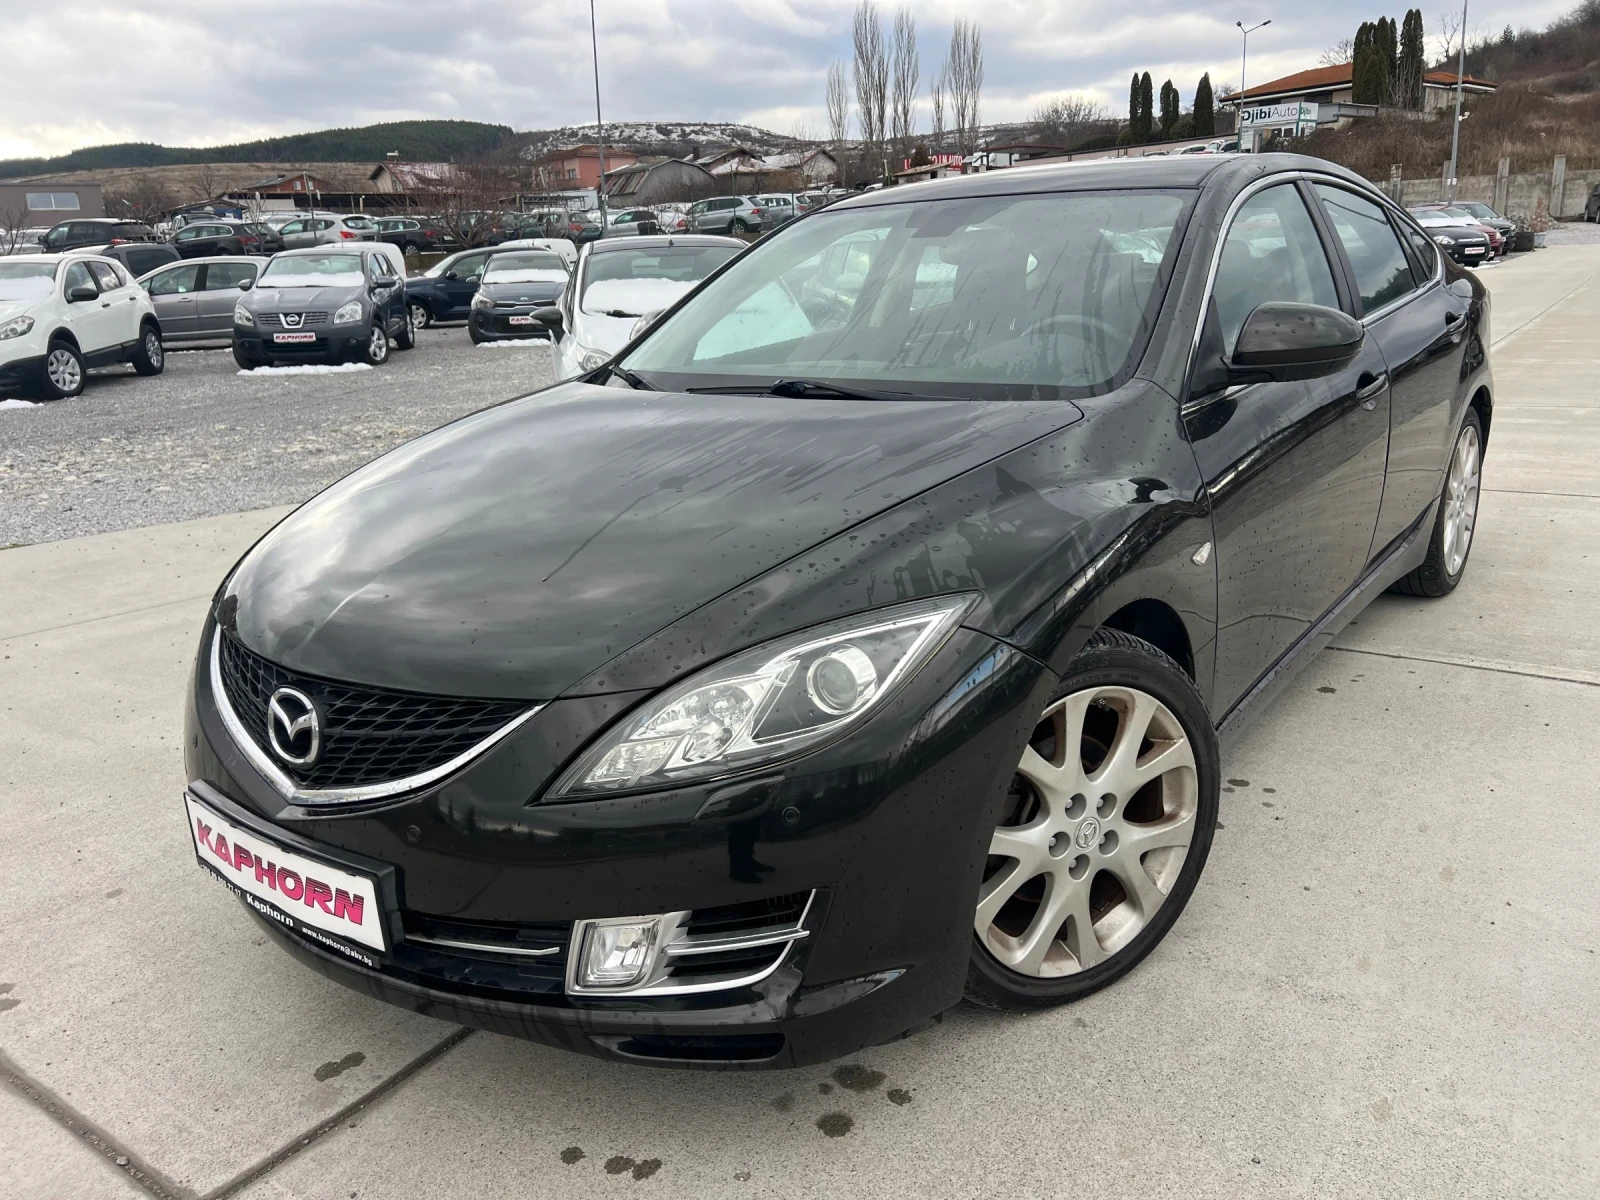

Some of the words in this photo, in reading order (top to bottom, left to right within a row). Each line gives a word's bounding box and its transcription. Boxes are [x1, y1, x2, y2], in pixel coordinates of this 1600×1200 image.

[196, 817, 364, 926] KAPHORN
[246, 893, 294, 927] Kaphorn
[301, 926, 373, 967] www.kaphorn@abv.bg
